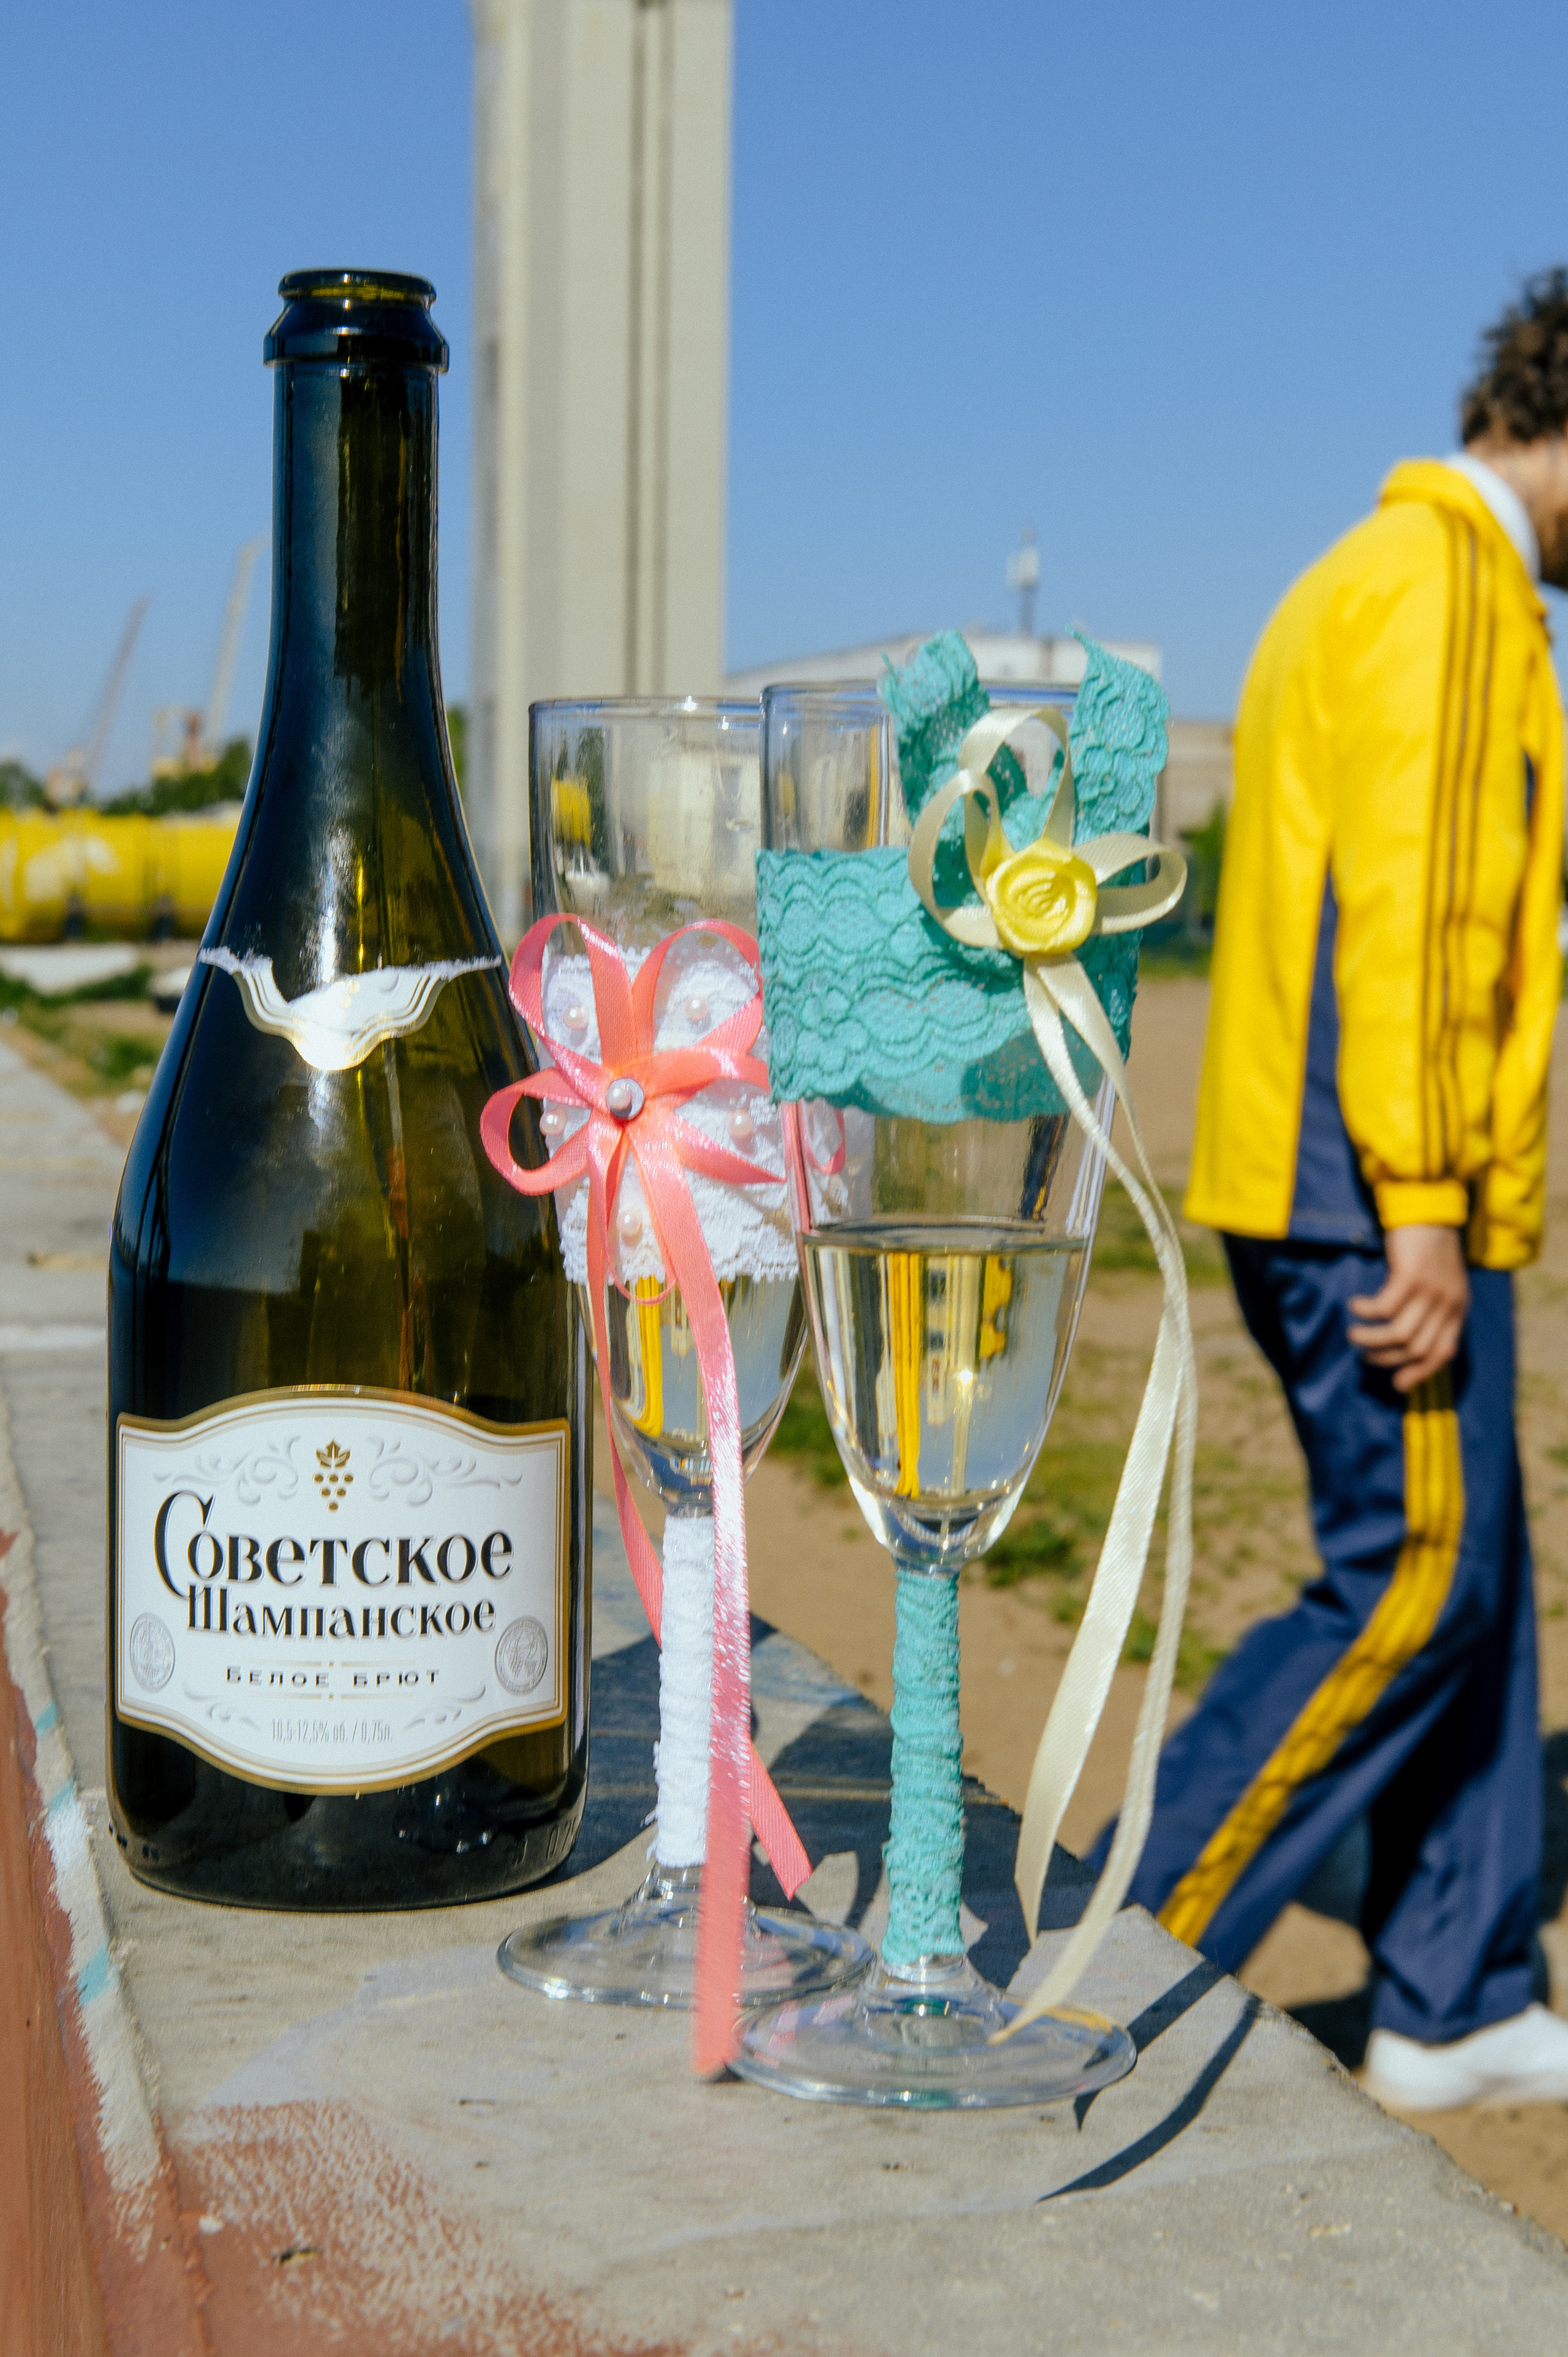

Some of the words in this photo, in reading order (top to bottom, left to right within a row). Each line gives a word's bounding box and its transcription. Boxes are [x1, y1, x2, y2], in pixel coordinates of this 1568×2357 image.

[154, 1490, 513, 1600] Советское
[187, 1582, 496, 1640] Шампанское
[226, 1665, 330, 1688] БЕЛОЕ
[352, 1668, 440, 1689] БРЮТ
